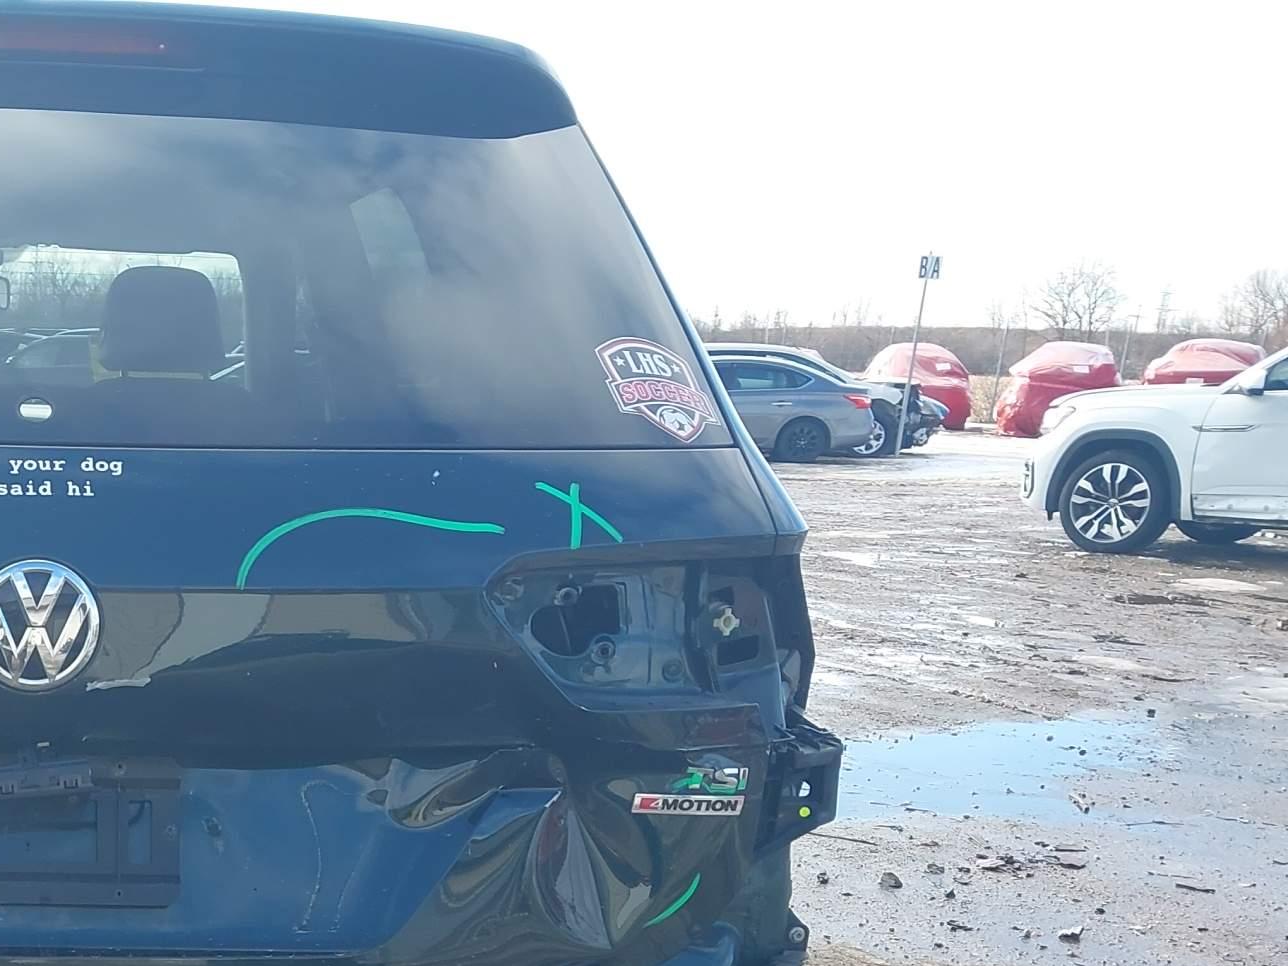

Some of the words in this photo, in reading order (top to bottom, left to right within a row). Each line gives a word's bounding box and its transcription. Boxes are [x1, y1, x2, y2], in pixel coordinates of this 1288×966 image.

[622, 350, 672, 377] LHS
[619, 381, 711, 416] SOCCER
[9, 457, 66, 475] your
[80, 457, 123, 476] dog
[66, 480, 95, 497] hi
[648, 798, 739, 812] 4MOTION
